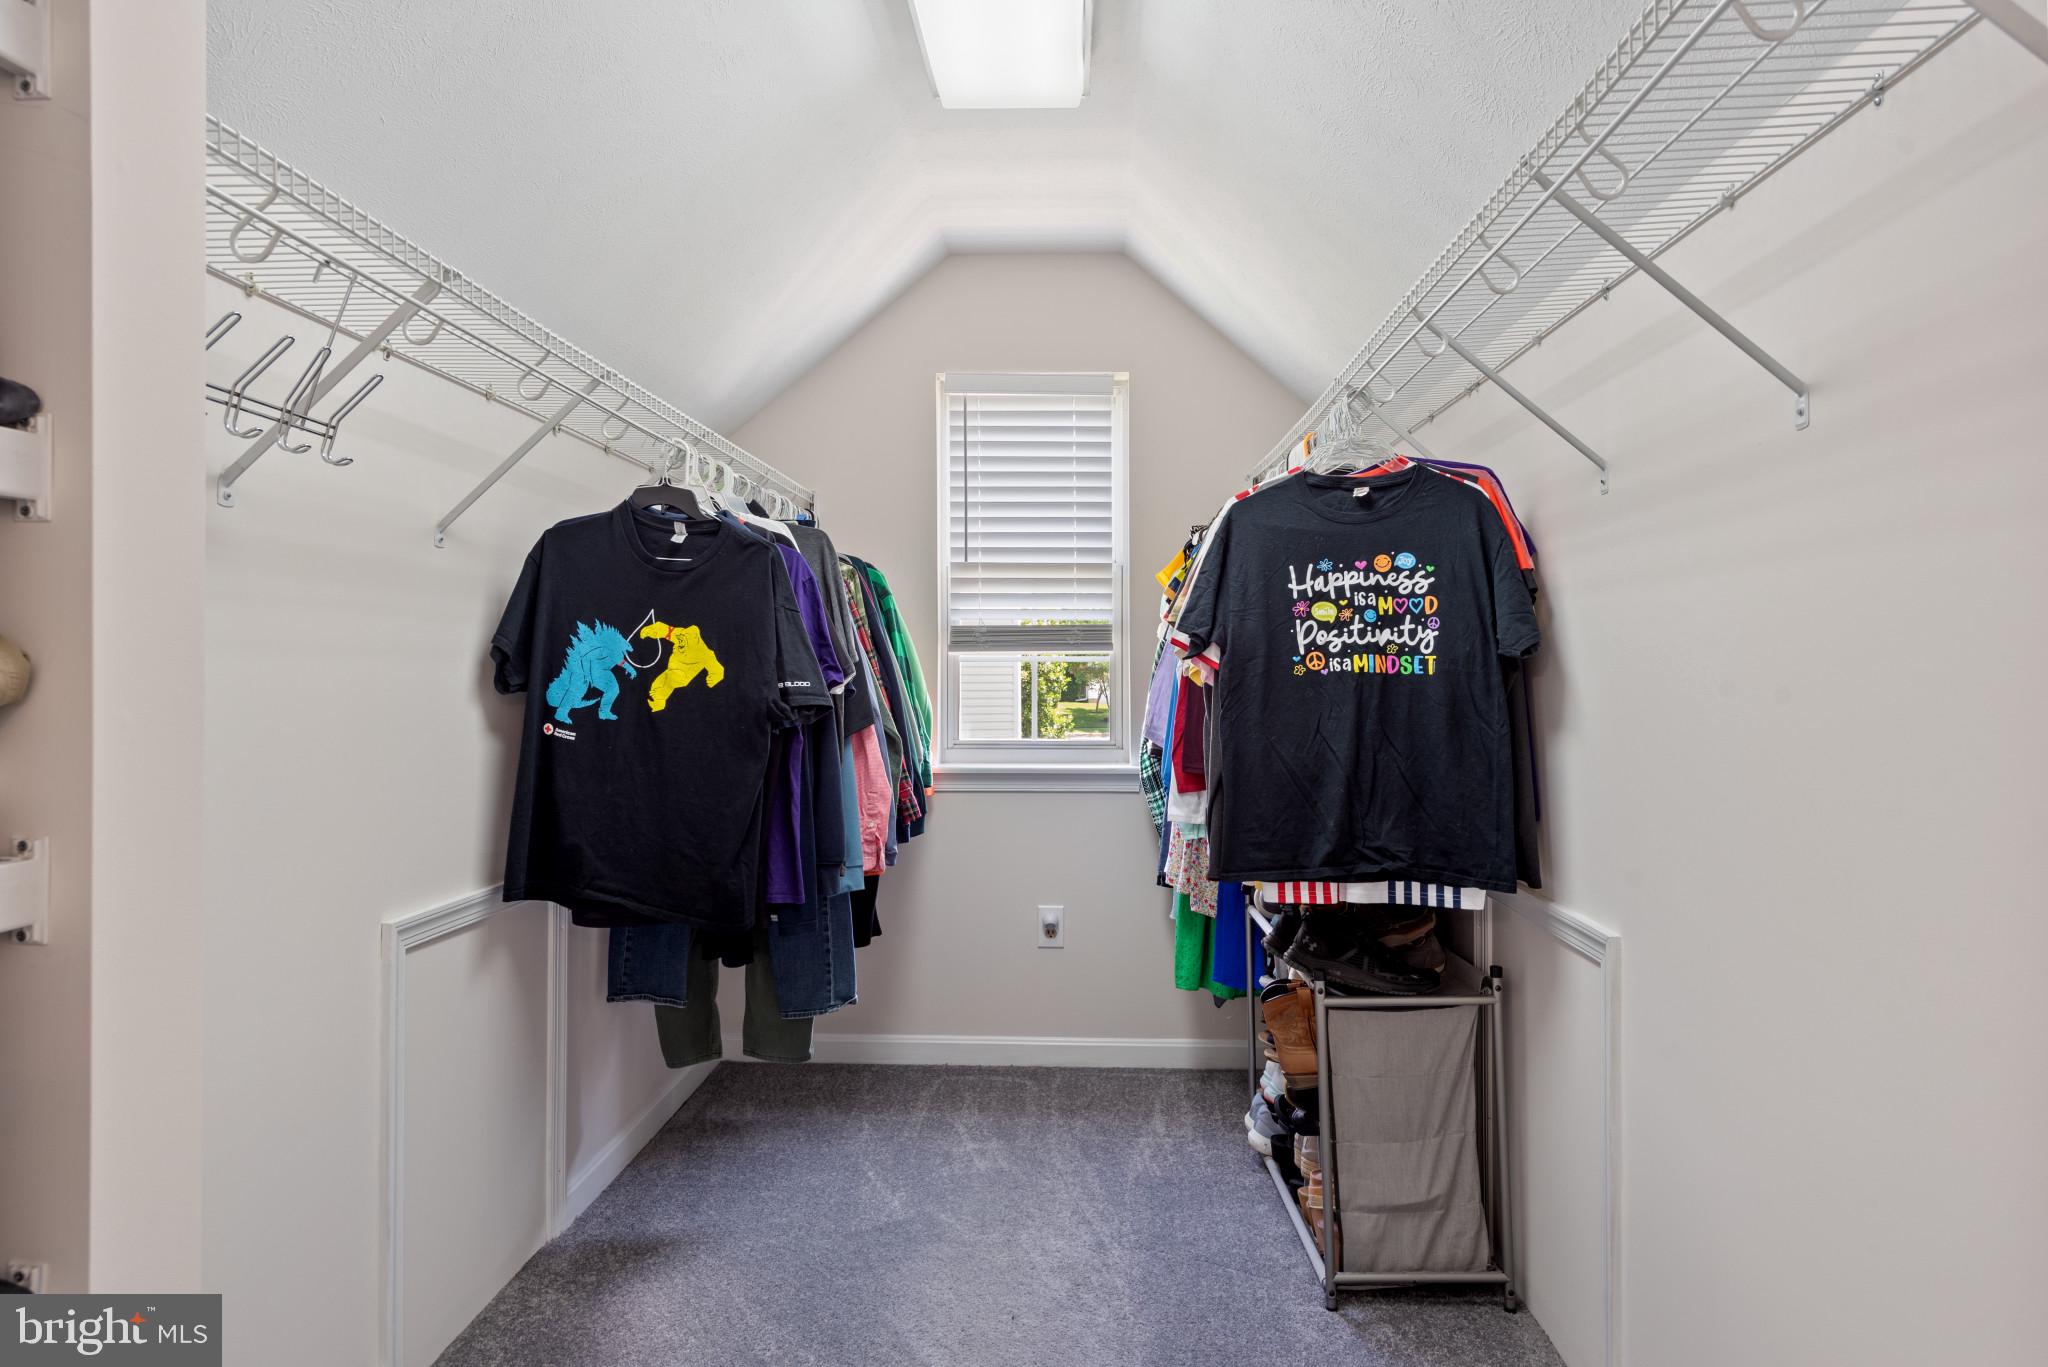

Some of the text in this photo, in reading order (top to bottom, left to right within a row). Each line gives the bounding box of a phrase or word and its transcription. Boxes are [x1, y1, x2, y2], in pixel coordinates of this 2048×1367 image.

[1287, 563, 1436, 599] Happiness
[1354, 592, 1366, 606] is
[1367, 595, 1376, 606] a
[1295, 614, 1439, 655] Positivity
[1329, 654, 1437, 676] is a MINDSET
